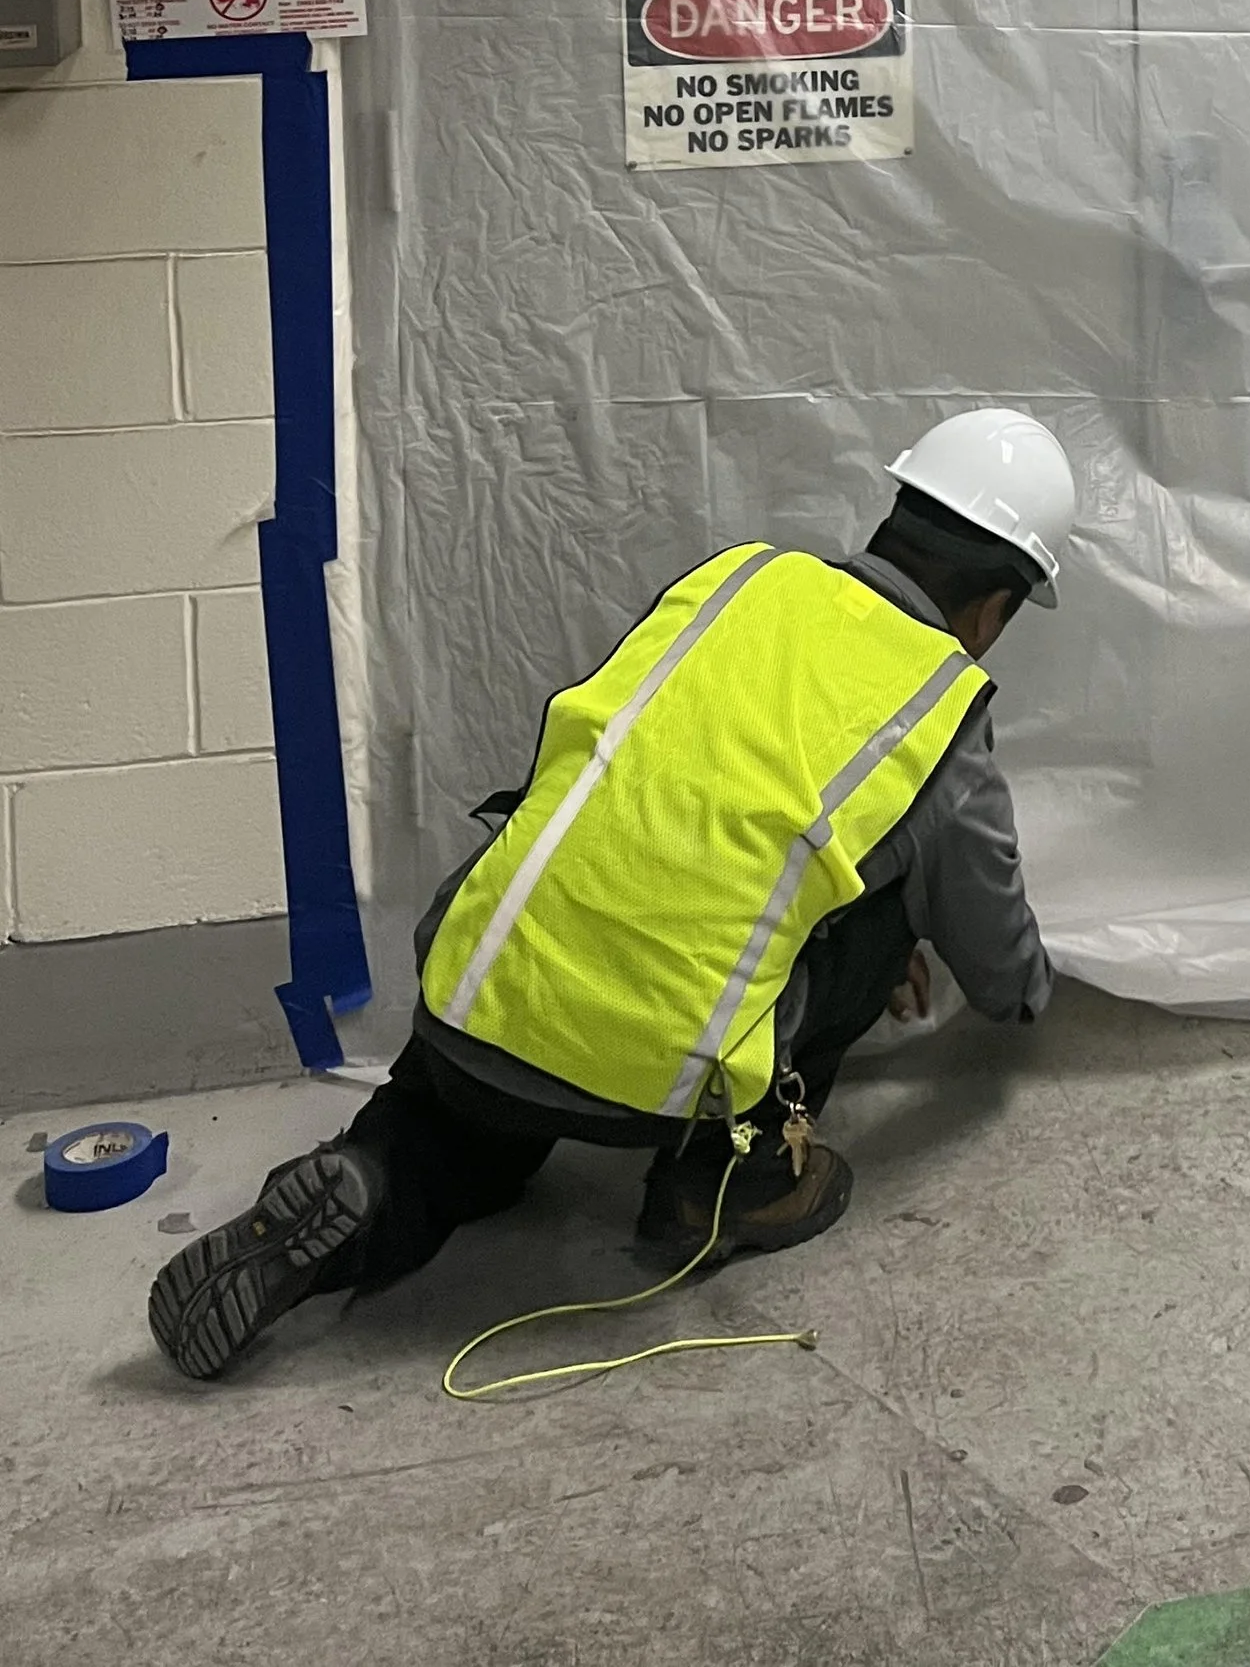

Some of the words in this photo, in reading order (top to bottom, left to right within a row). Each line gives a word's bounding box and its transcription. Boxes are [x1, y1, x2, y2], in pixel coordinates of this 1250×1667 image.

[676, 75, 717, 98] NO
[726, 70, 860, 96] SMOKING
[643, 104, 685, 127] NO
[694, 101, 773, 125] OPEN
[783, 95, 894, 122] FLAMES
[688, 130, 729, 153] NO
[737, 125, 852, 151] SPARKS
